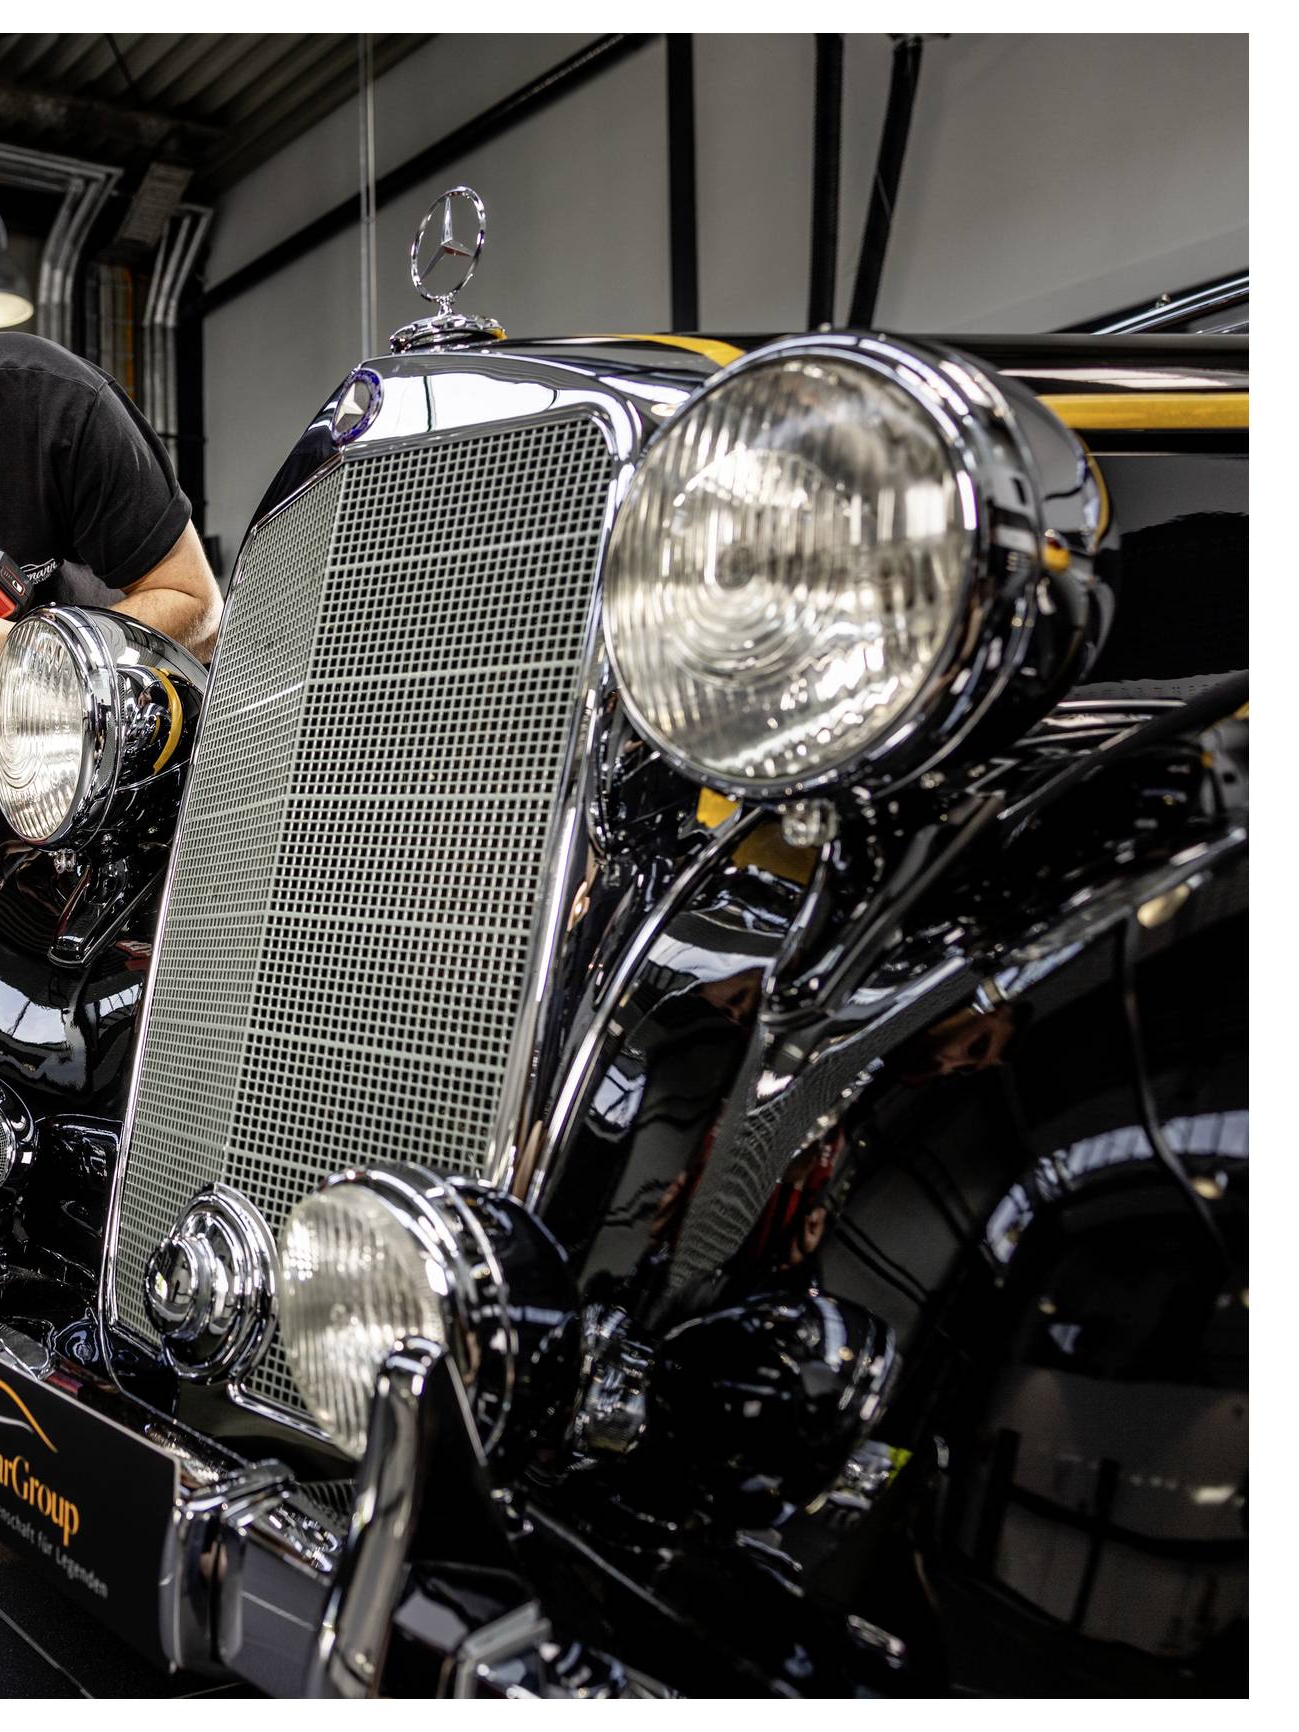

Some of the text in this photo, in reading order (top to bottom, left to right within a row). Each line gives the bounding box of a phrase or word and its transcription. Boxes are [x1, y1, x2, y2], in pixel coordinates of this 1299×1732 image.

[26, 561, 58, 581] mann
[37, 1530, 53, 1556] für
[55, 1546, 109, 1600] Legenden
